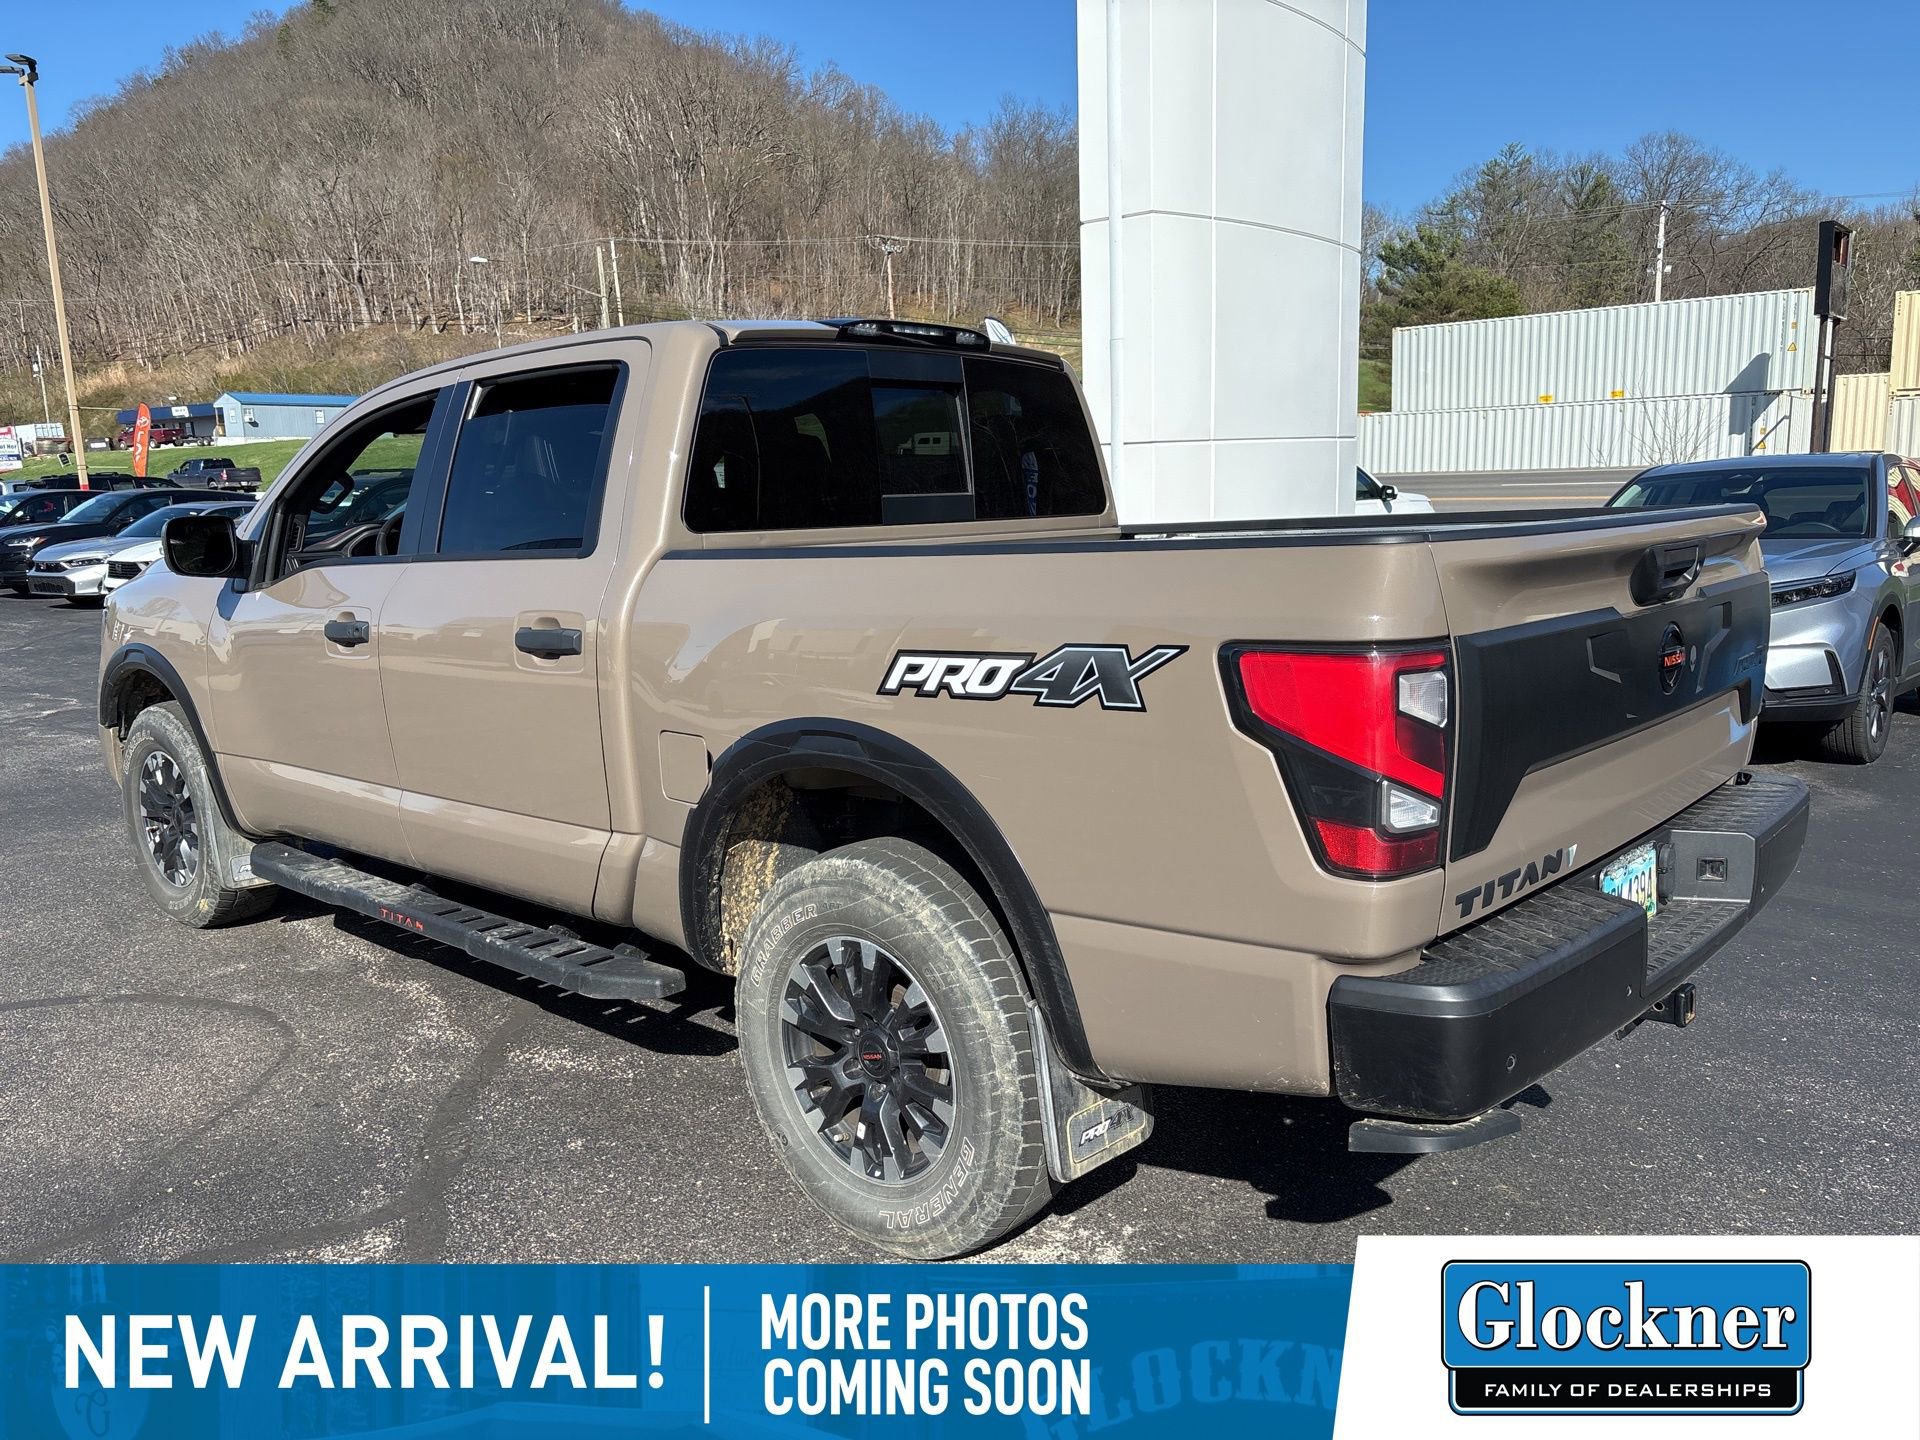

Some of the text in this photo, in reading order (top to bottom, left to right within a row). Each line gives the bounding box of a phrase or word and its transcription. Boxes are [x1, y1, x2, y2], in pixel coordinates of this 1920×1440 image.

[379, 906, 425, 932] TITAN
[1455, 848, 1563, 919] TITAN
[751, 903, 818, 987] GRABBER
[879, 1136, 975, 1229] GENERAL
